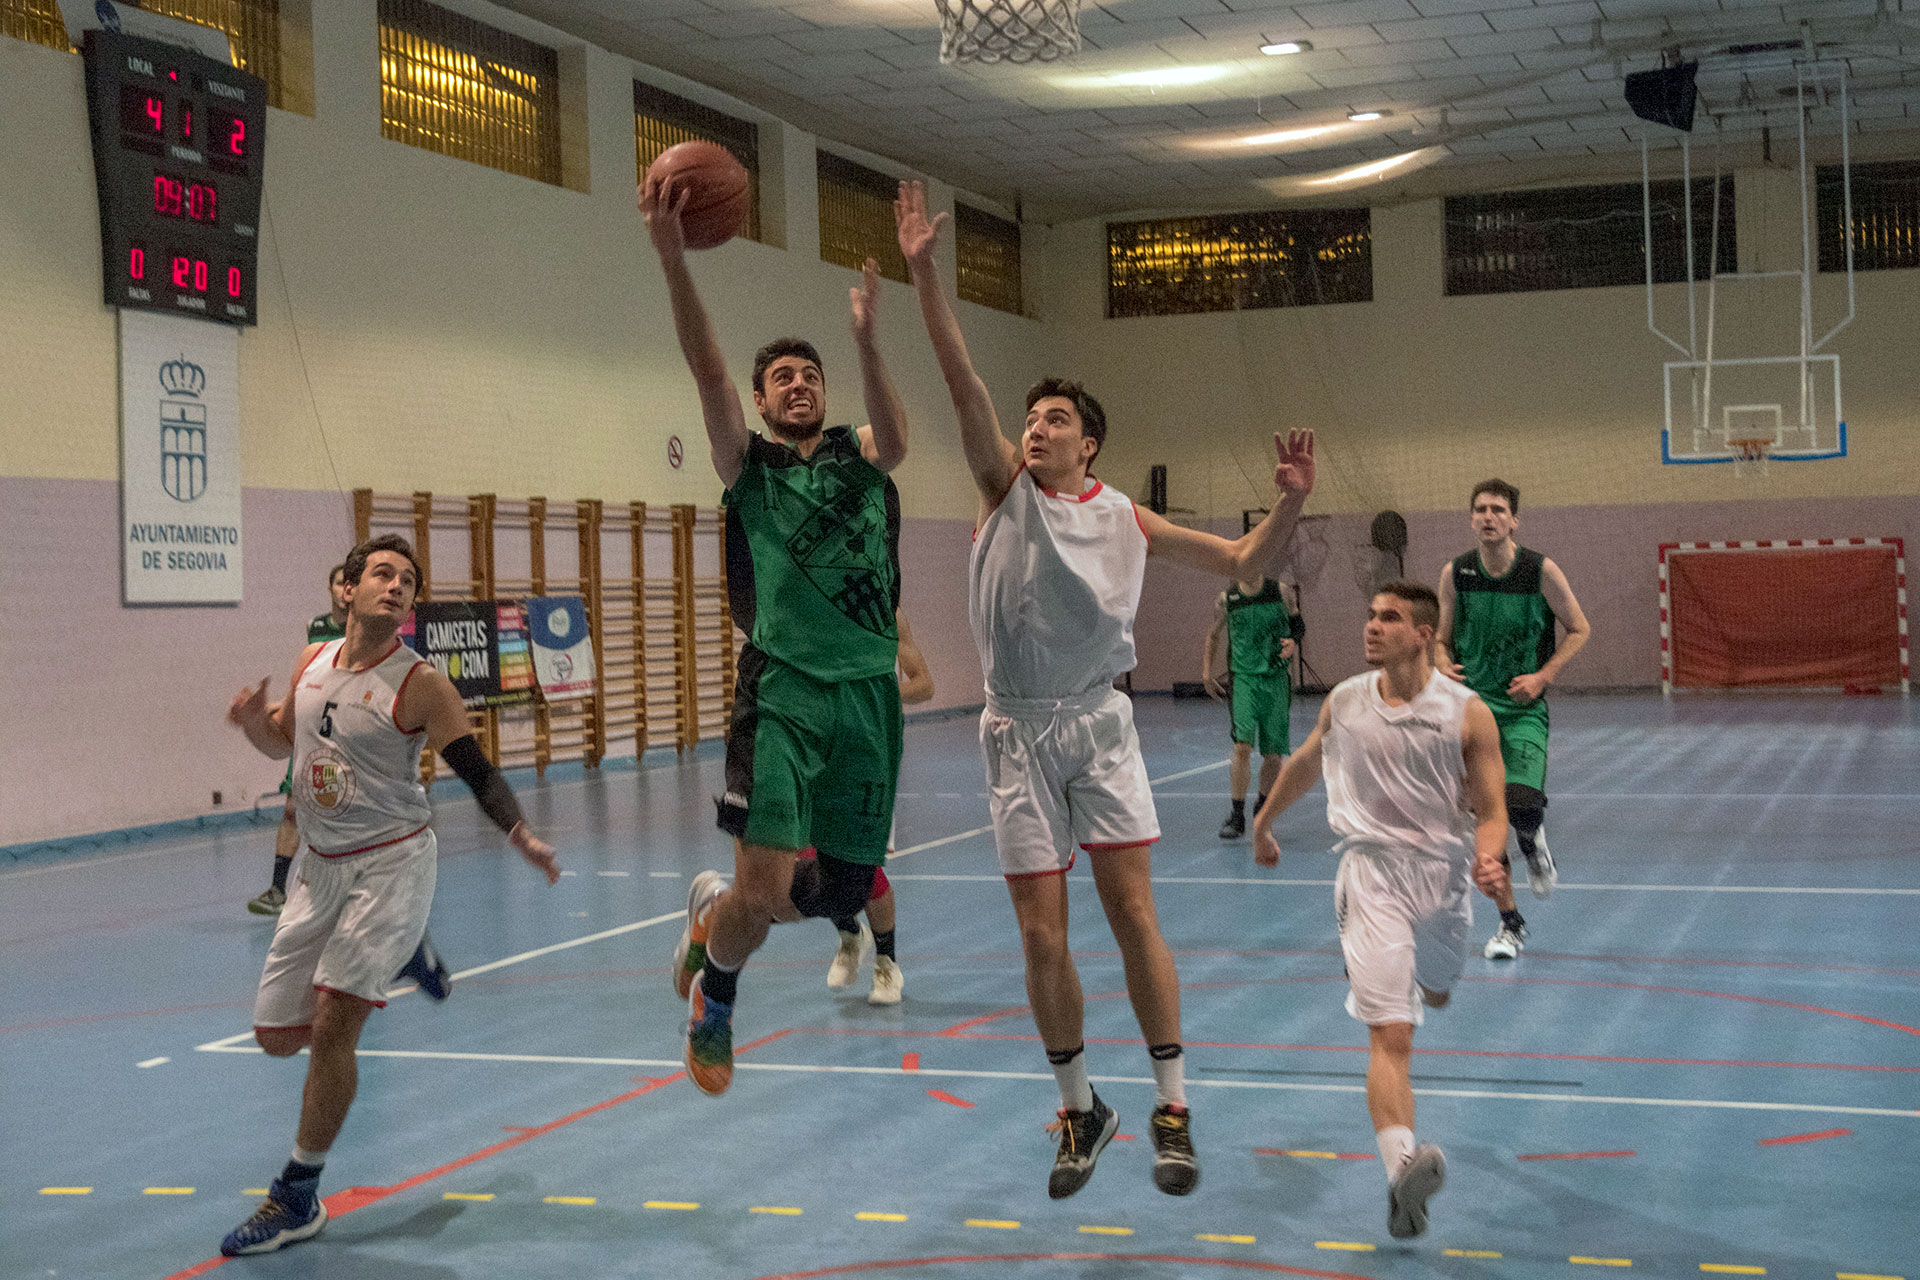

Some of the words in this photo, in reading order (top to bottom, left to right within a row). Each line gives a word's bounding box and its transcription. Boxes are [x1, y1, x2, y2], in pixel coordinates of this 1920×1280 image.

[127, 56, 155, 78] LOCAL
[146, 97, 162, 131] 4
[230, 119, 245, 155] 2
[130, 248, 144, 279] 0
[228, 266, 241, 297] 0
[130, 523, 238, 545] AYUNTAMIENTO
[142, 551, 161, 570] DE
[167, 551, 227, 571] SEGOVIA
[426, 620, 488, 650] CAMISETAS
[319, 701, 338, 738] 5
